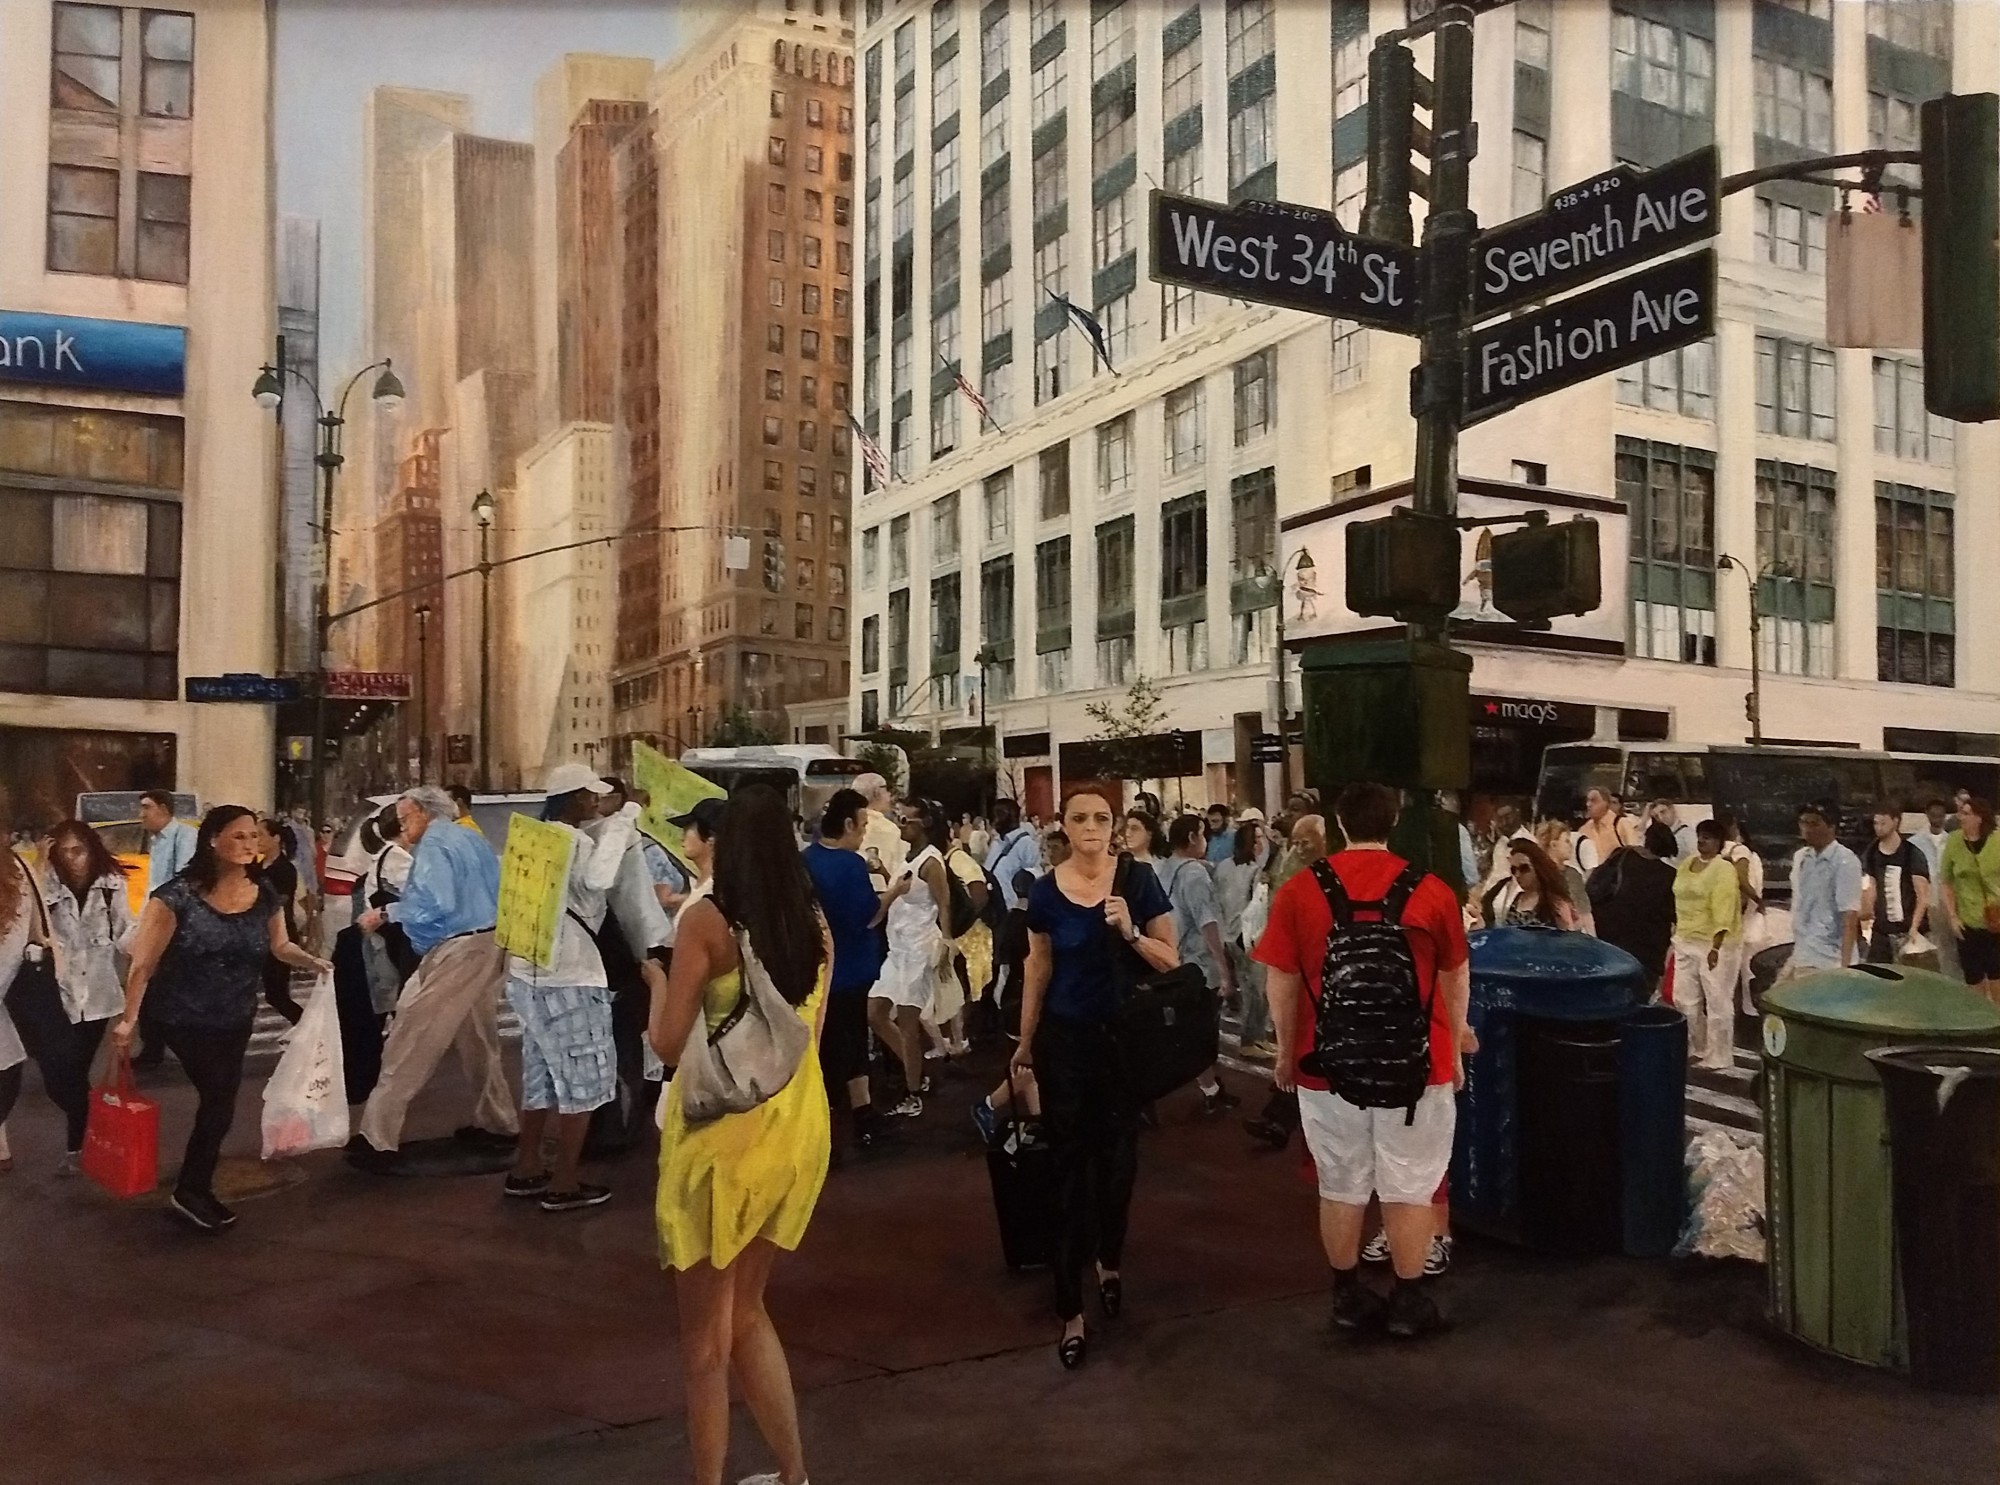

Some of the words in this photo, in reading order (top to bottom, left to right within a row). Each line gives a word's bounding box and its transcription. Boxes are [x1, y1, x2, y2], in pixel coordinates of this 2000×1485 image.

[1484, 204, 1624, 294] Seventh
[1632, 187, 1708, 242] Ave
[1554, 193, 1578, 210] 438
[1593, 177, 1621, 196] 420
[1170, 211, 1280, 281] West
[1289, 233, 1358, 294] 34th
[1360, 253, 1403, 307] St
[1482, 318, 1618, 394] Fashion
[1630, 288, 1699, 342] Ave
[1501, 702, 1558, 725] macy's
